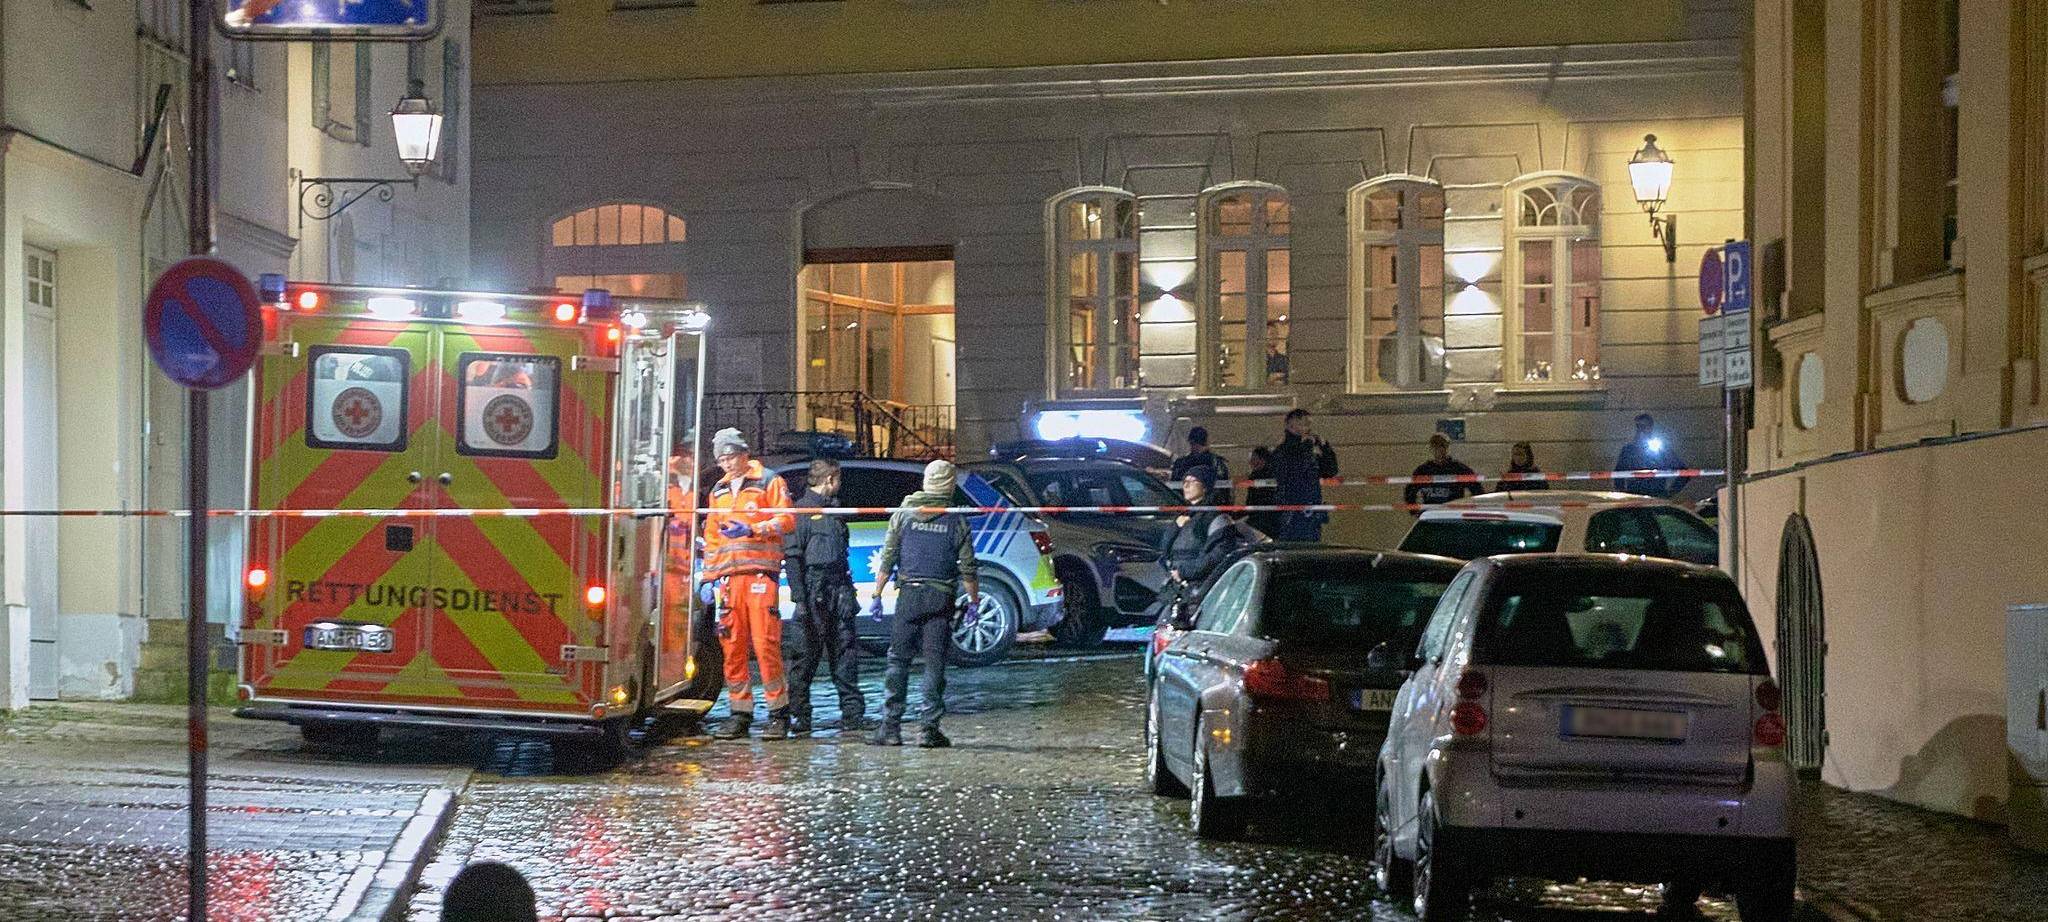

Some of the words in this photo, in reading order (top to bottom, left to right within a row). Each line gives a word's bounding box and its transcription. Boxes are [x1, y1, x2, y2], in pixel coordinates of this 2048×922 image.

[1728, 251, 1742, 303] P
[911, 522, 948, 533] POLIZEI
[287, 580, 562, 614] RETTUNGSDIENST
